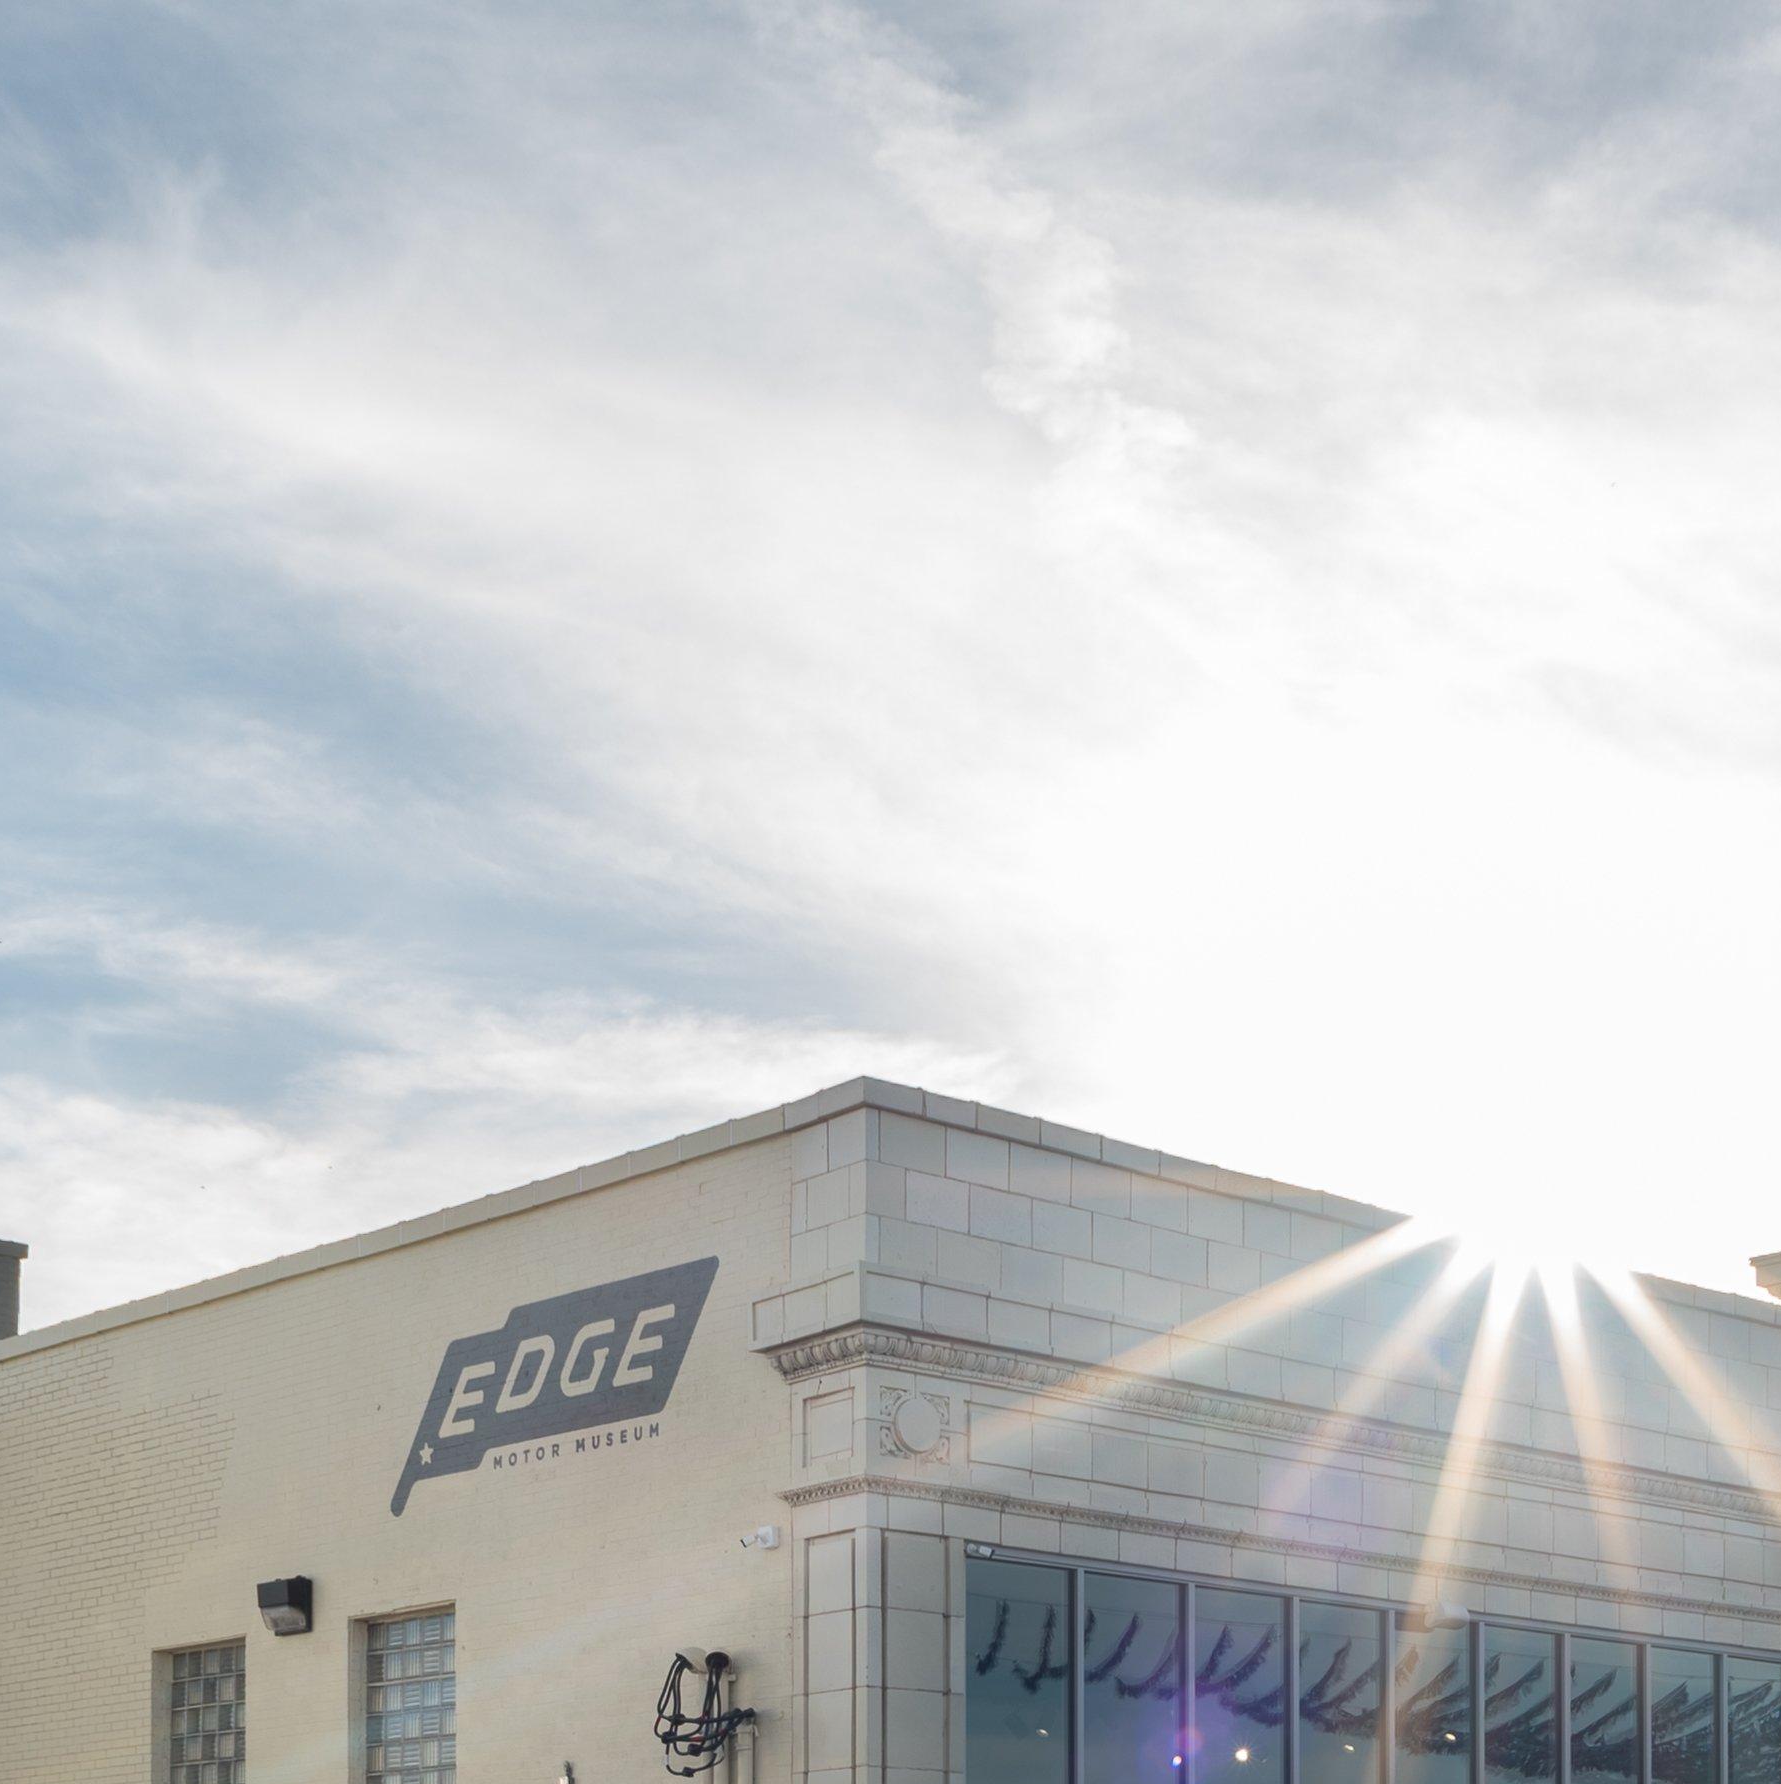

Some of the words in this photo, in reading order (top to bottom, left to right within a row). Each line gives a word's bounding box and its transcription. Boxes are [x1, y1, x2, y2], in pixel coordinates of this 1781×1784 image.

[438, 1303, 675, 1439] EDGE
[493, 1442, 560, 1470] MOTOR
[575, 1421, 661, 1453] MUSEUM
